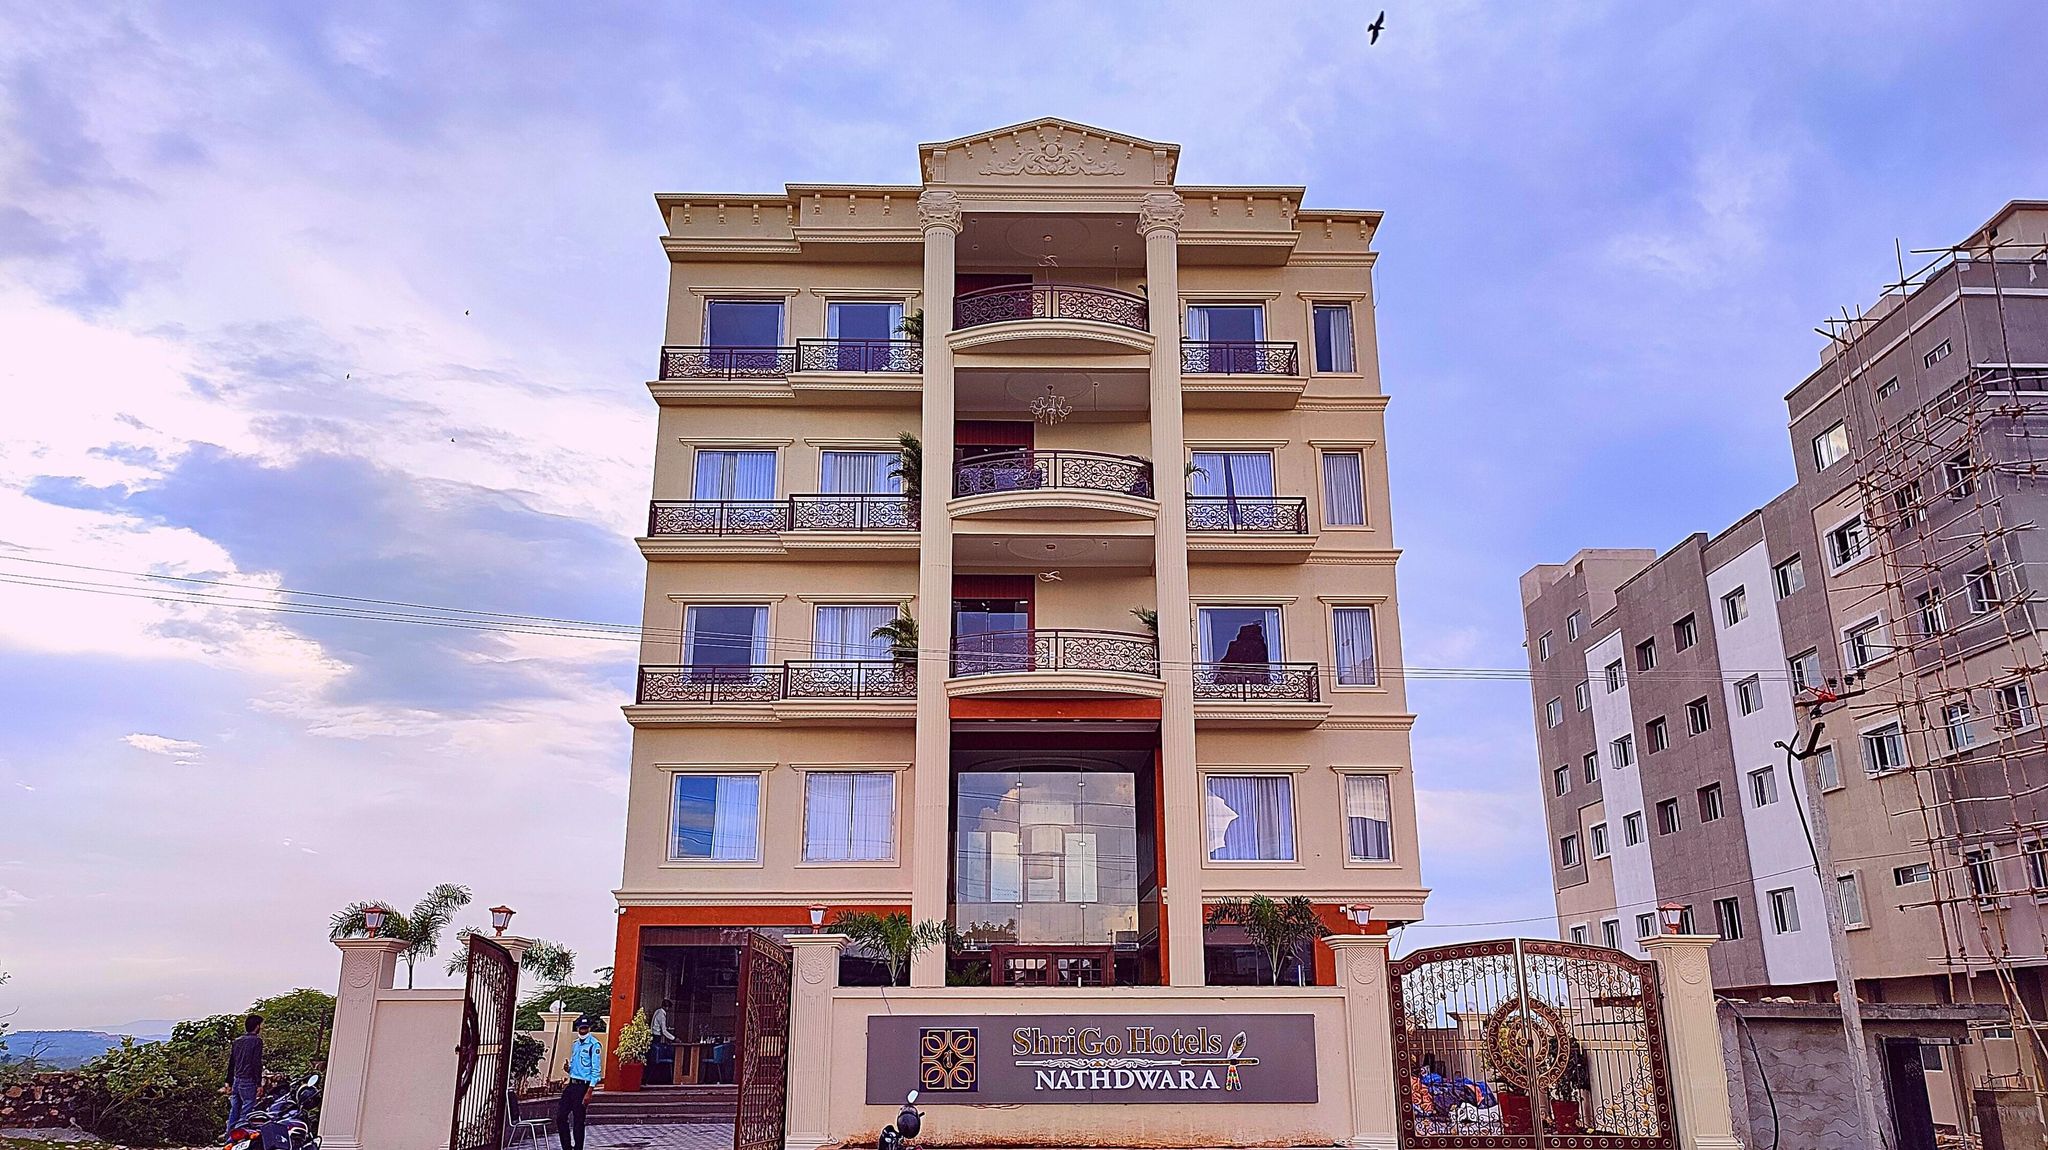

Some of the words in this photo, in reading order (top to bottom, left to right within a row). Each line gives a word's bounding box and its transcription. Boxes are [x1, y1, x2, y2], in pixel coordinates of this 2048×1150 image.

[1012, 1027, 1122, 1056] ShriGo
[1126, 1027, 1222, 1055] Hotels
[1035, 1069, 1220, 1090] NATHDWARA
